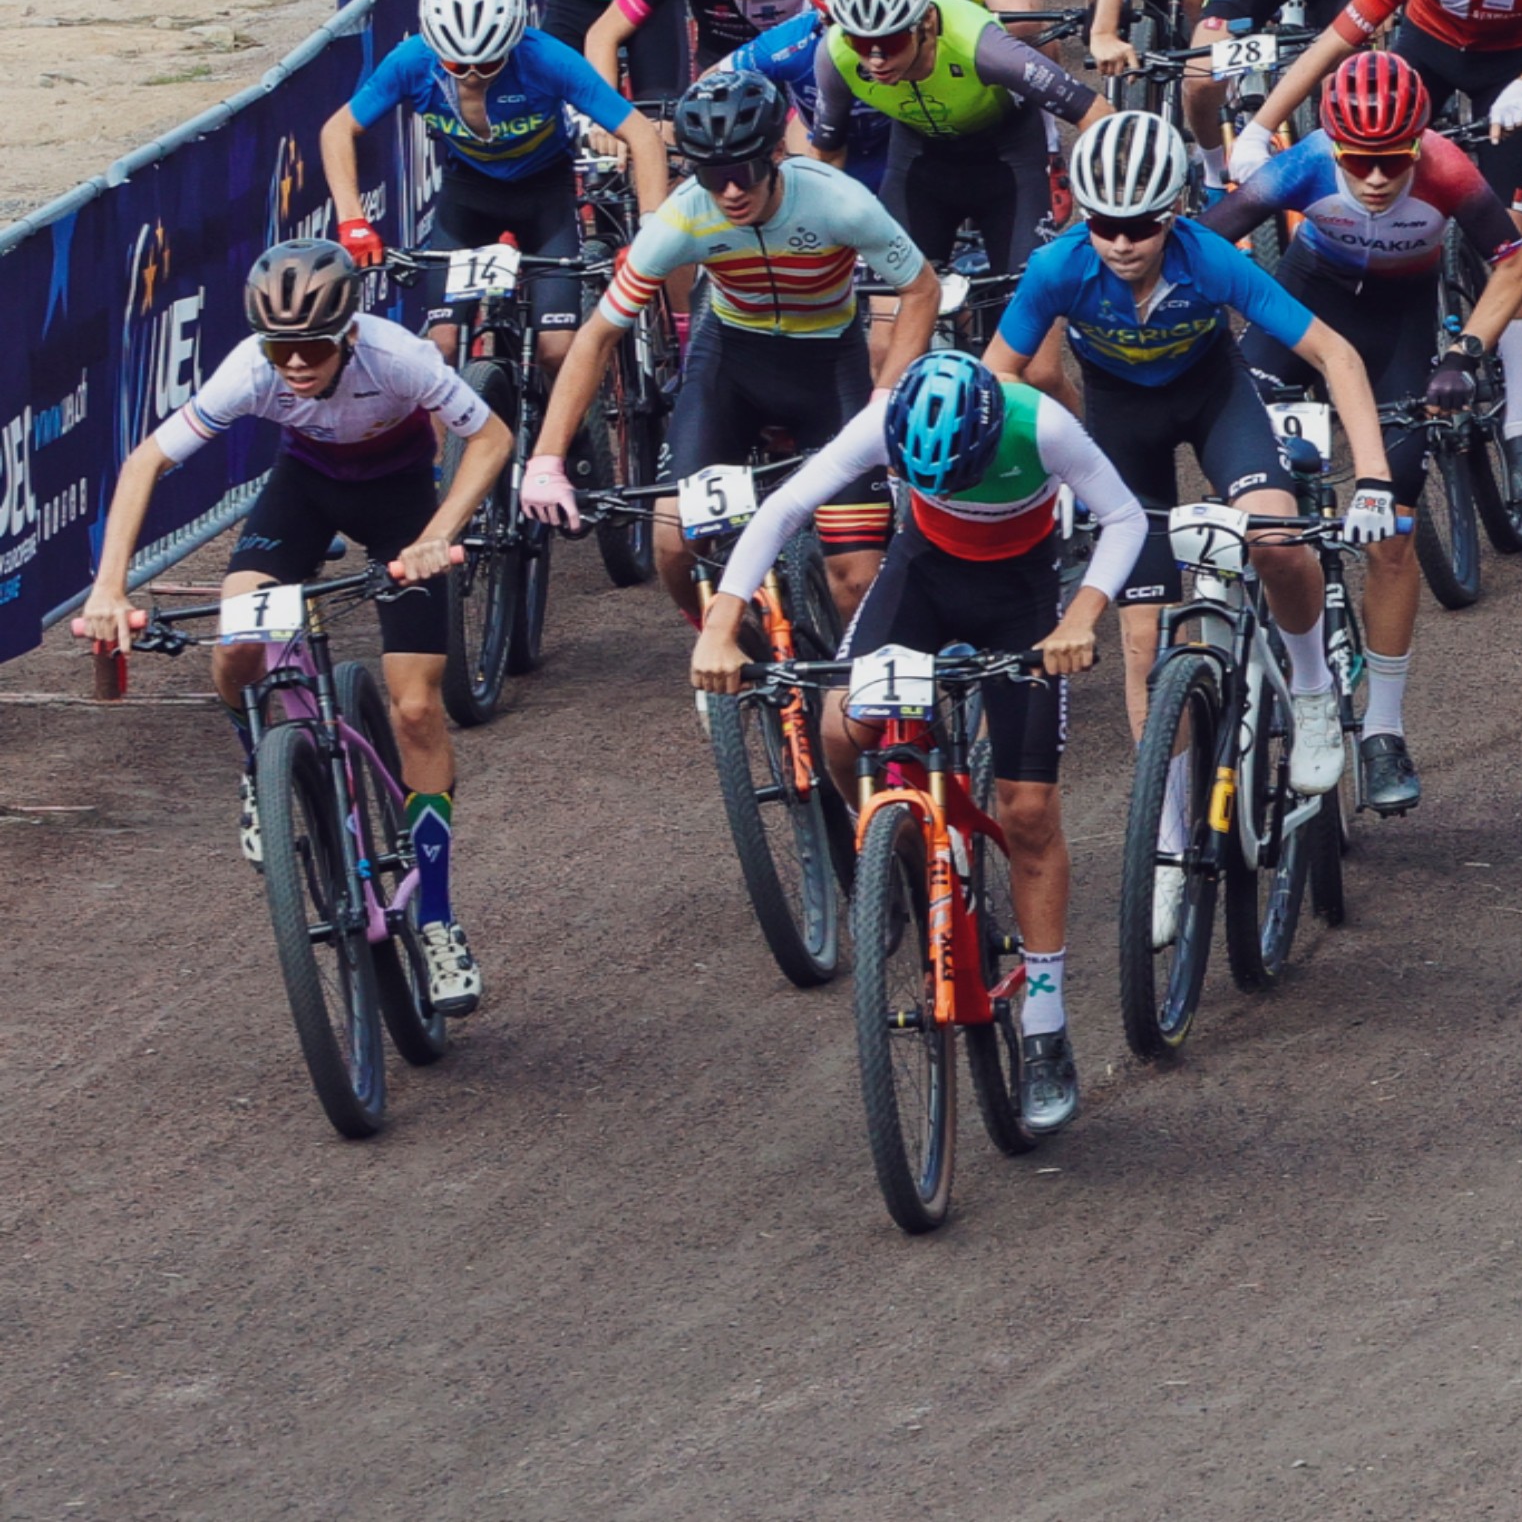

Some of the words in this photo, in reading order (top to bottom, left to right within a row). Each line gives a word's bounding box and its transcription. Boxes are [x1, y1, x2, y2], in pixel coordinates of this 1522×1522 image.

[1227, 41, 1262, 66] 28
[1323, 228, 1428, 251] SLOVAKIA
[464, 255, 498, 289] 14
[705, 476, 727, 516] 5
[1197, 525, 1217, 565] 2
[252, 591, 271, 628] 7
[1125, 584, 1165, 600] CCN
[882, 659, 901, 701] 1
